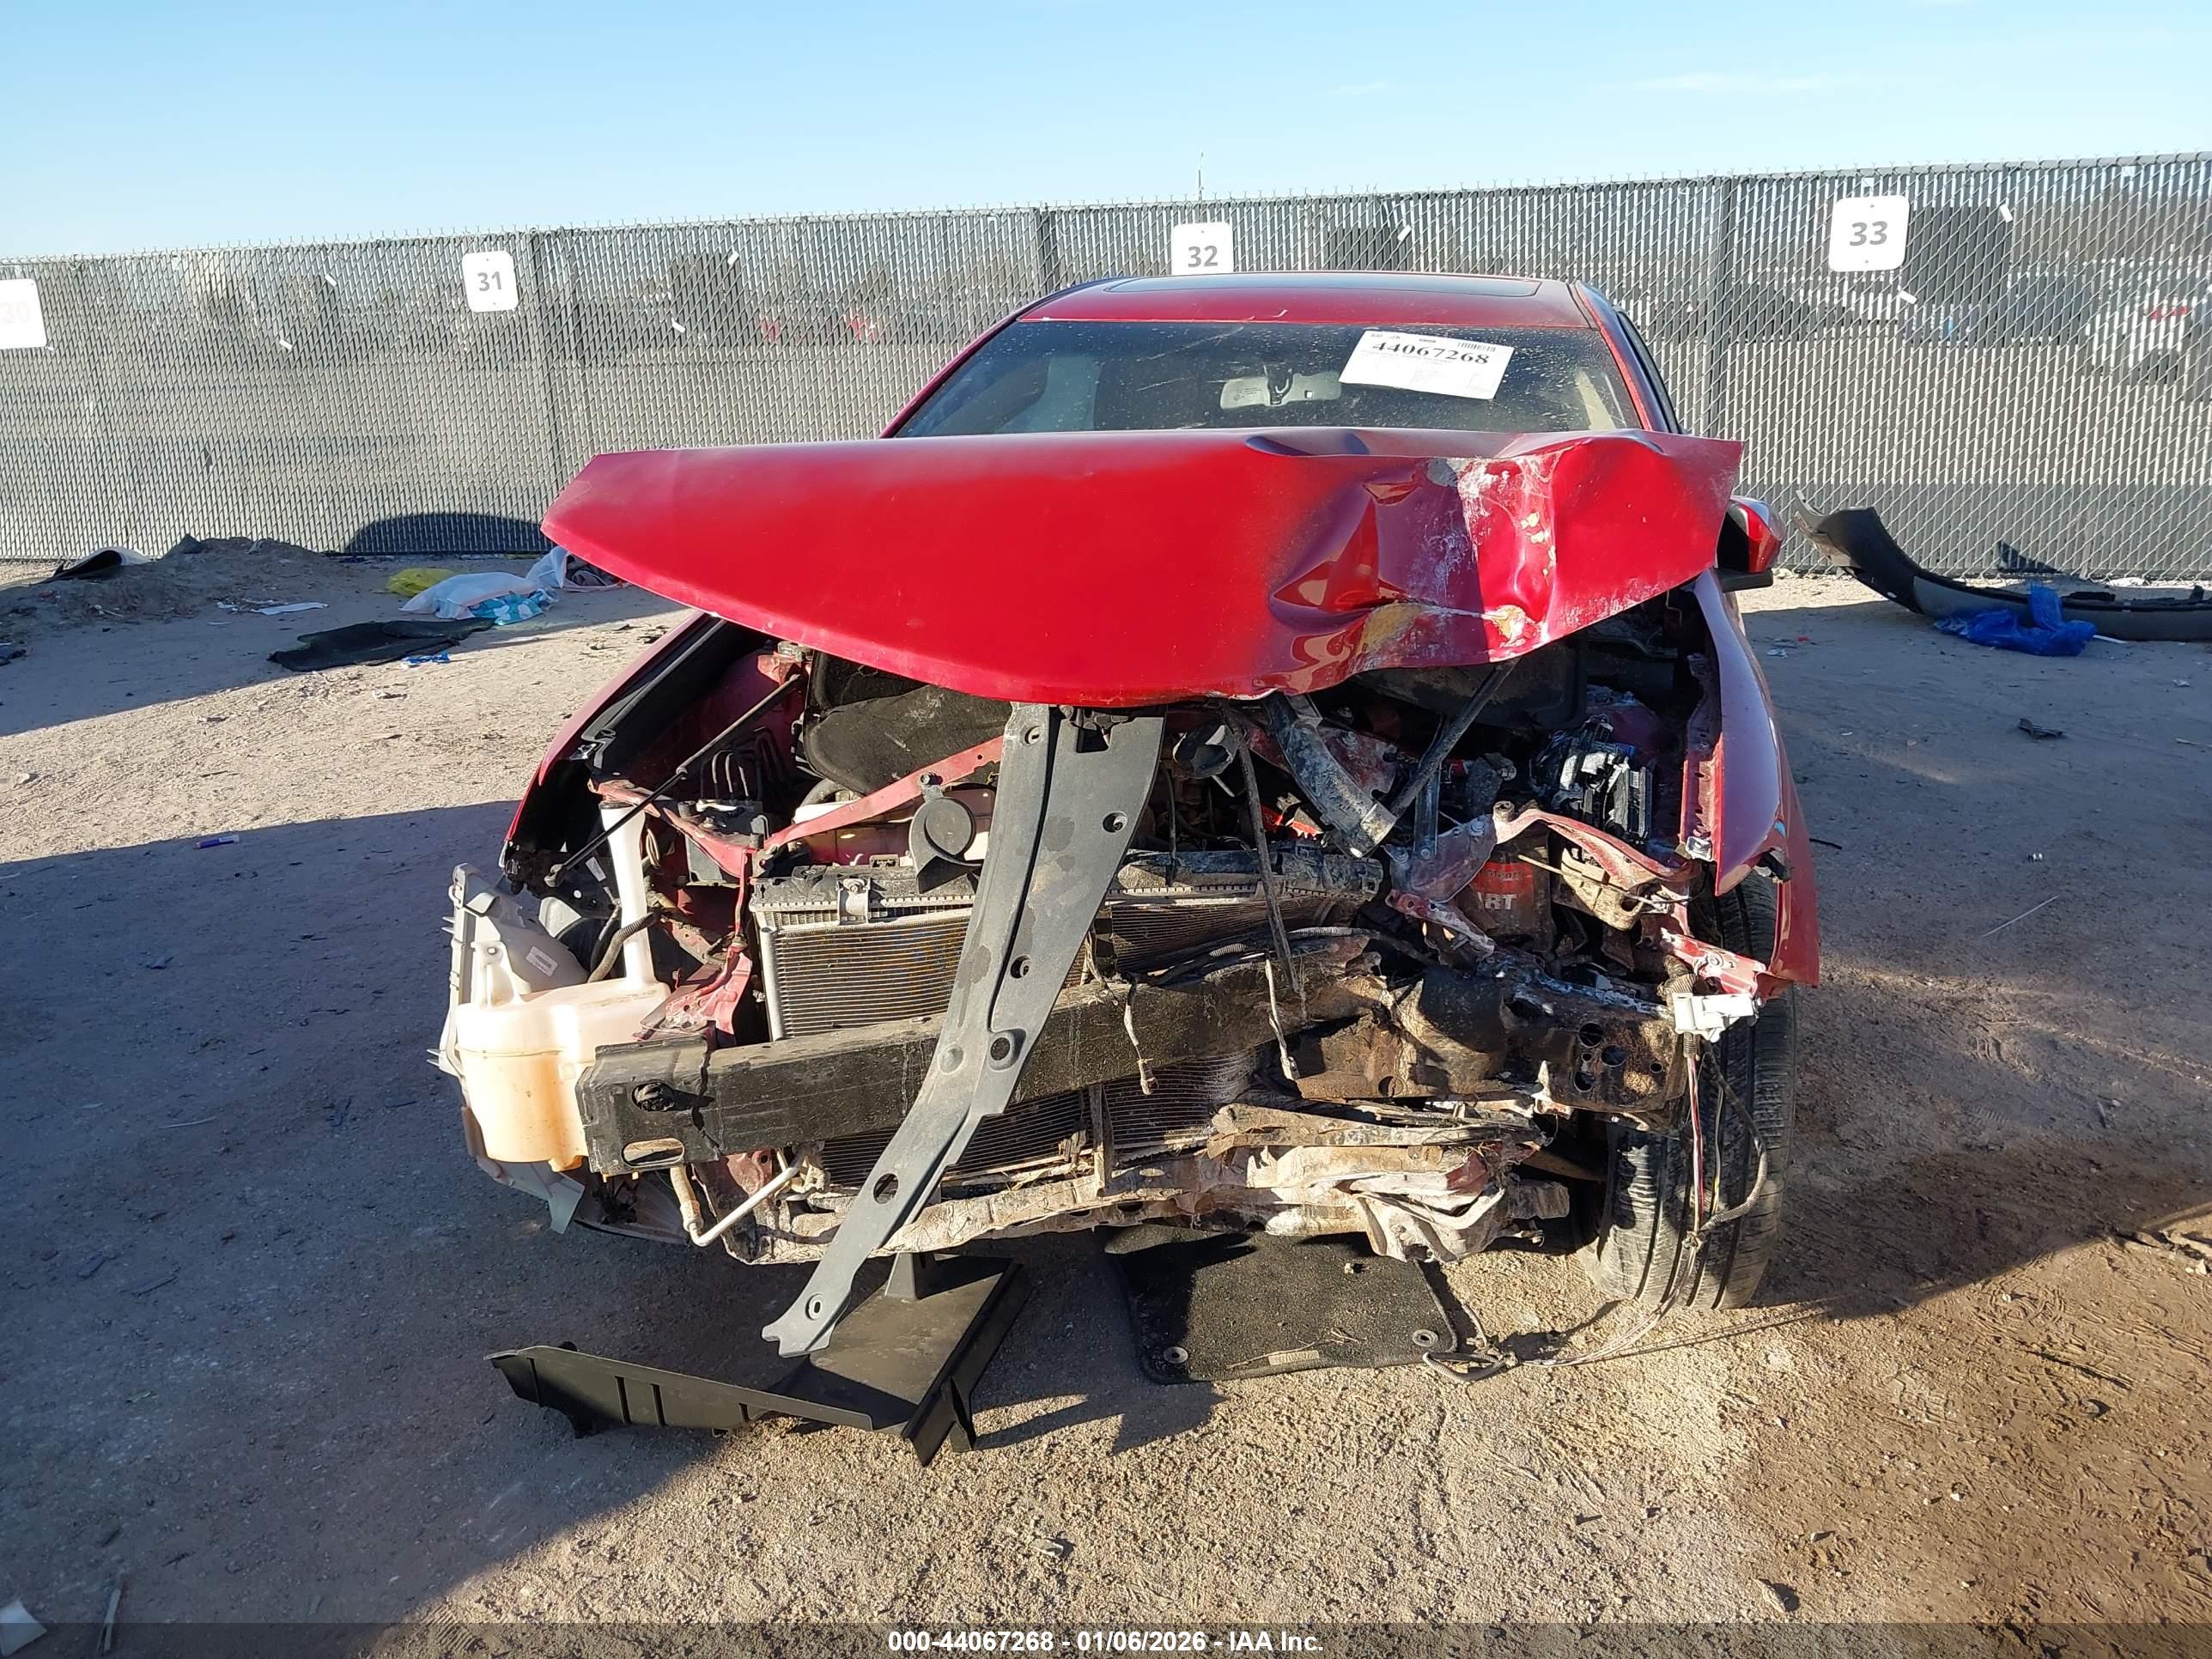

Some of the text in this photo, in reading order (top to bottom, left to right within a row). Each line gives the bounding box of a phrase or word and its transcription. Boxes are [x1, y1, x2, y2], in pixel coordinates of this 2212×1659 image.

[1849, 221, 1887, 246] 33
[1188, 245, 1218, 268] 32
[477, 270, 503, 292] 31
[1372, 342, 1490, 365] 44067268
